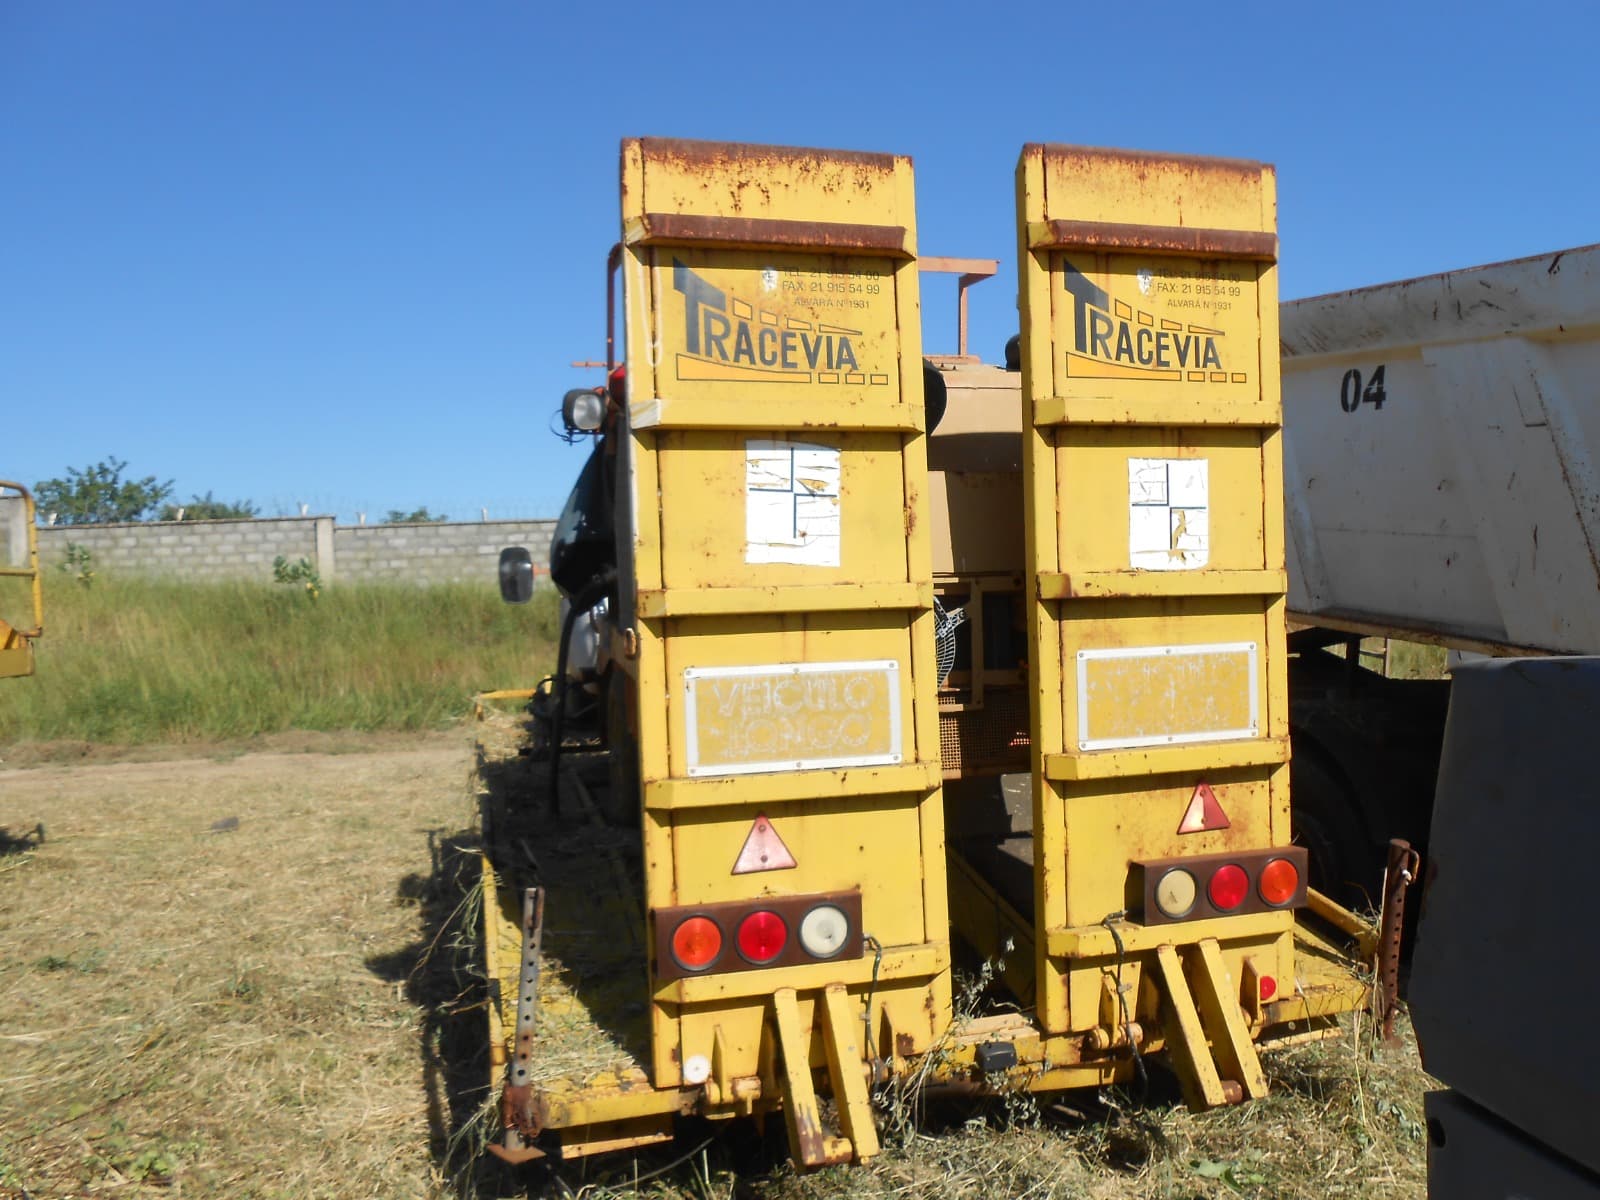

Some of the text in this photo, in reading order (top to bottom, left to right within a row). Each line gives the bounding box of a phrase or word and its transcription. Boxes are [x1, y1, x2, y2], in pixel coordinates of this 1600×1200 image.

[810, 282, 822, 292] 21
[827, 283, 845, 293] 915
[848, 284, 862, 294] 54
[866, 284, 880, 295] 99
[1157, 283, 1241, 296] FAX: 21 915 54 99
[673, 257, 859, 371] TRACEVIA
[1063, 261, 1222, 369] TRACEVIA
[1214, 301, 1232, 310] 1931
[1341, 364, 1386, 413] 04
